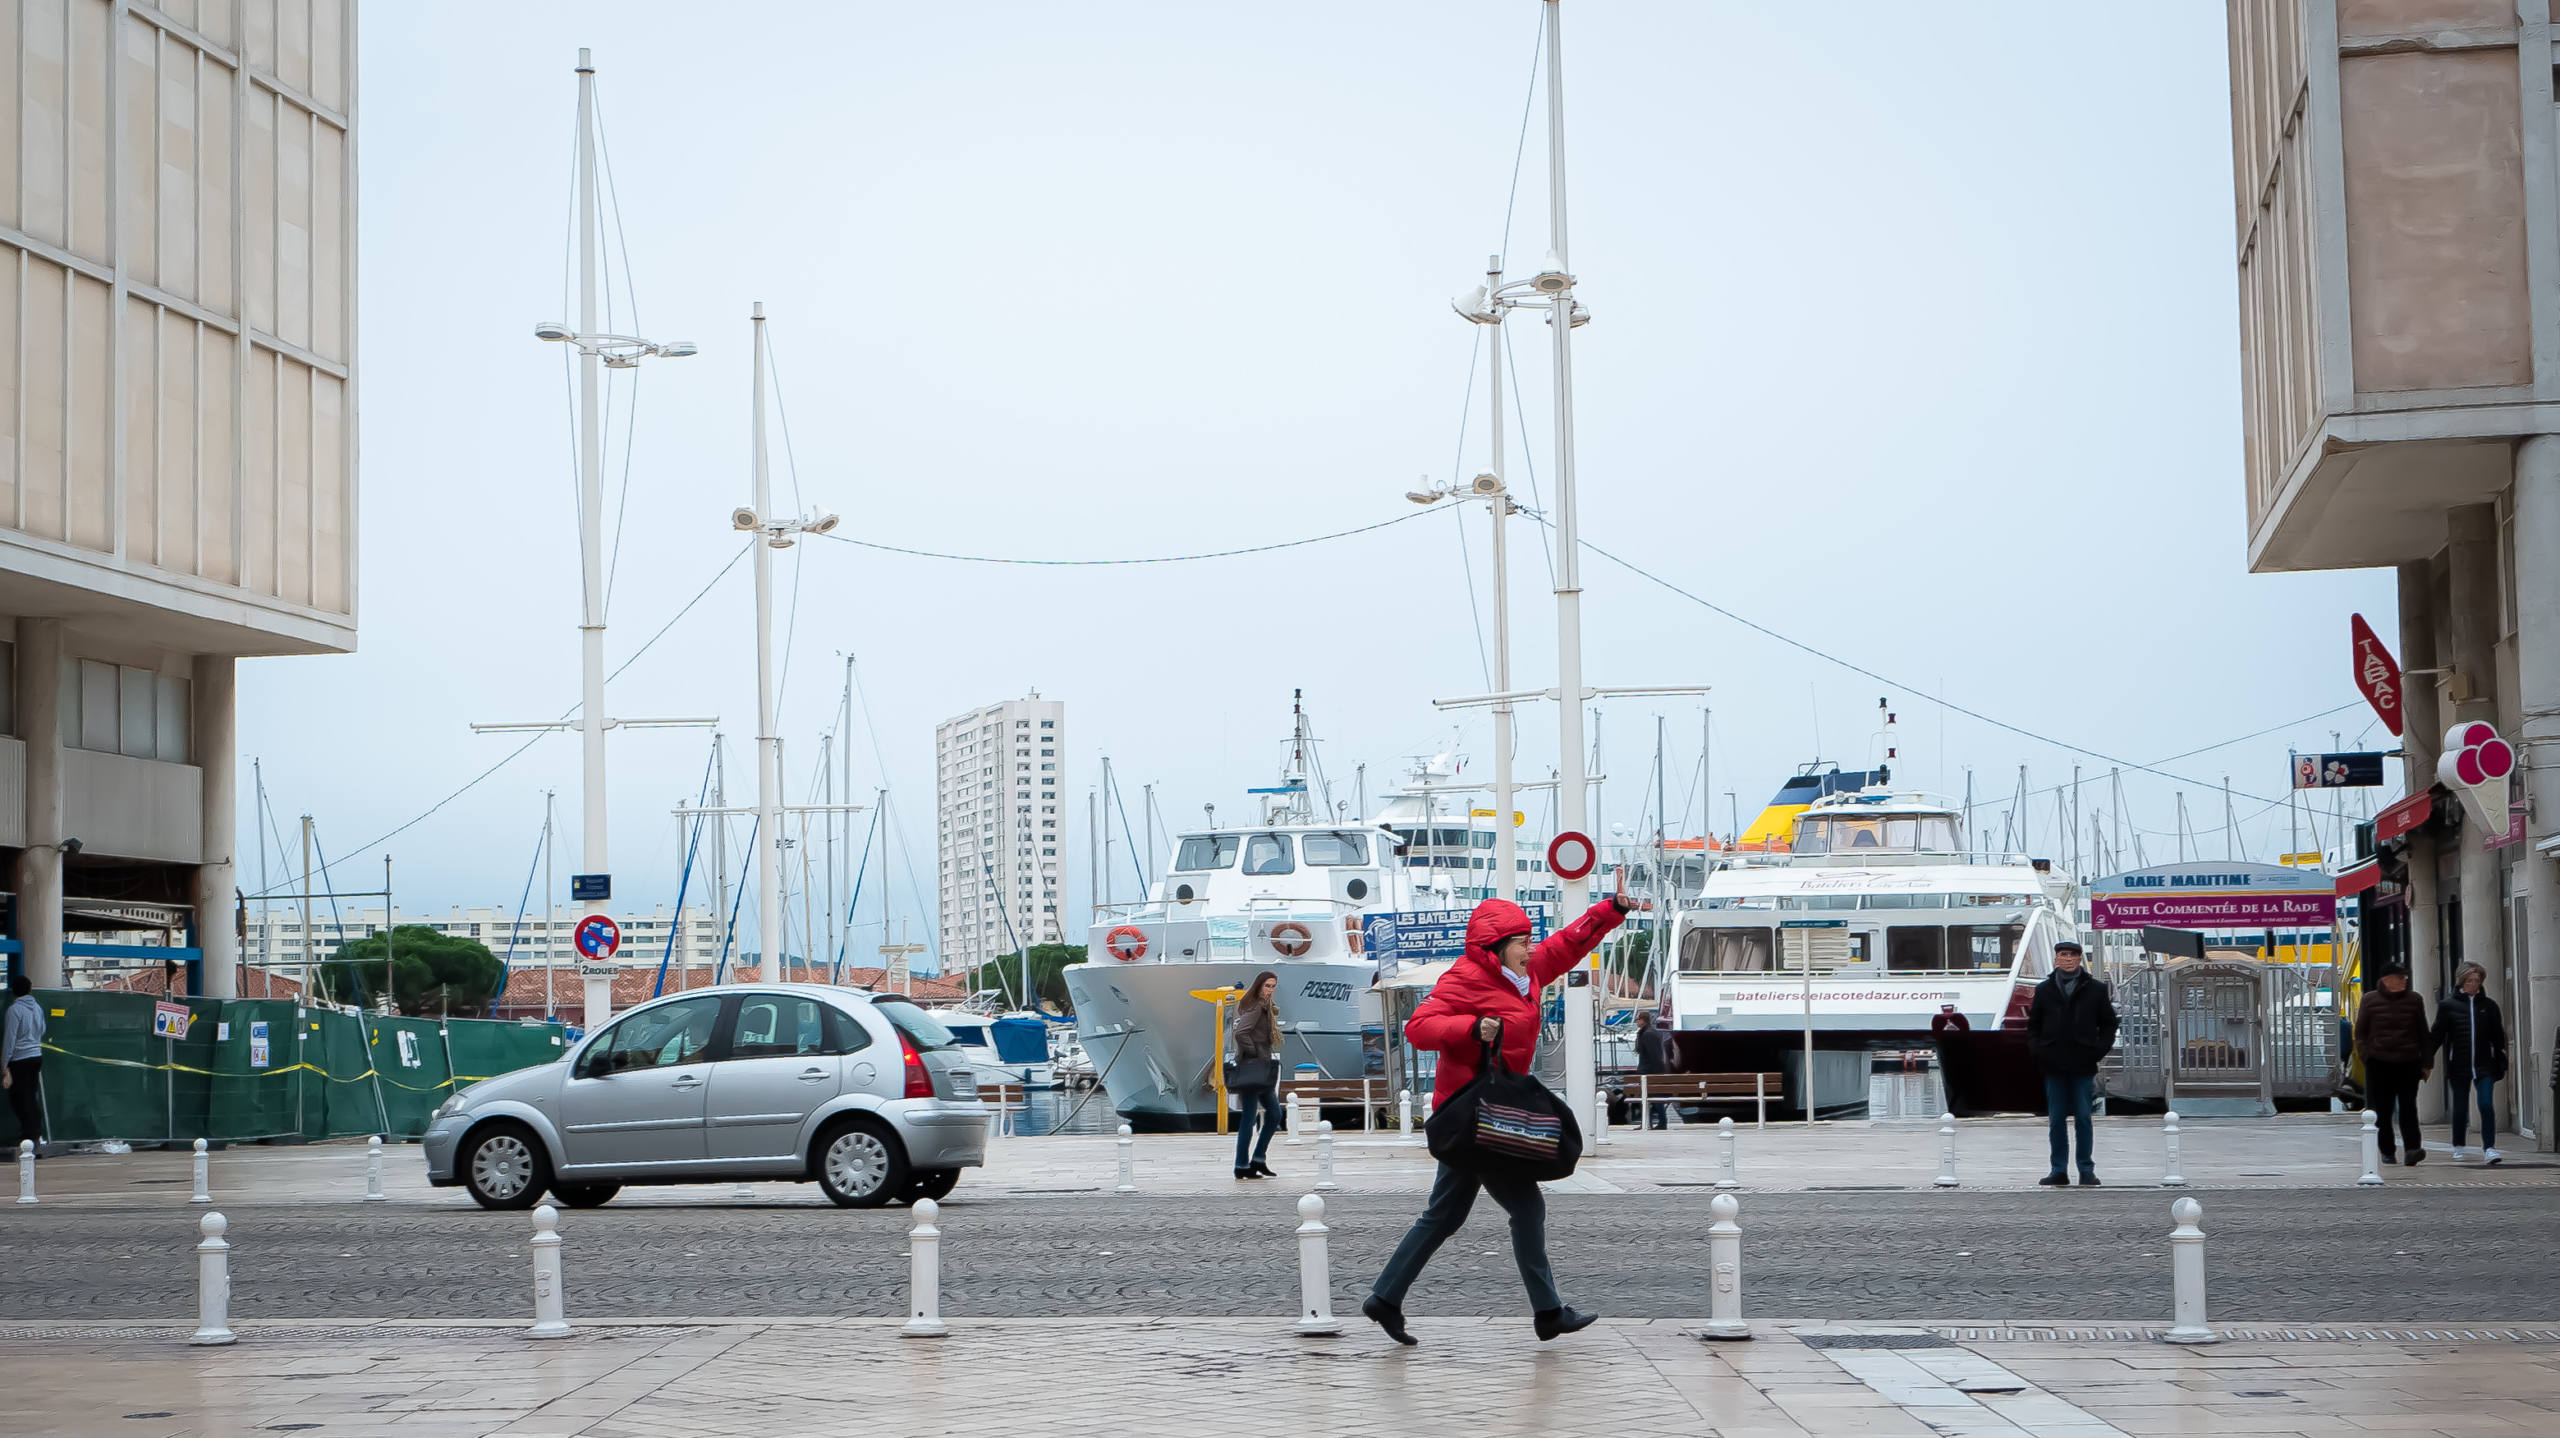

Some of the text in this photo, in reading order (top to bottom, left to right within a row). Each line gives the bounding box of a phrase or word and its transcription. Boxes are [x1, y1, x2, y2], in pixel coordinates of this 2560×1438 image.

[2358, 639, 2395, 709] TABAC
[2170, 874, 2251, 887] MARITIME
[2106, 900, 2320, 916] VISITE COMMENTÉE DE LA RADE
[1396, 913, 1416, 926] LES
[1418, 910, 1472, 924] BATELIERS
[1398, 930, 1444, 941] VISITE
[1300, 981, 1353, 1002] POSEIDON
